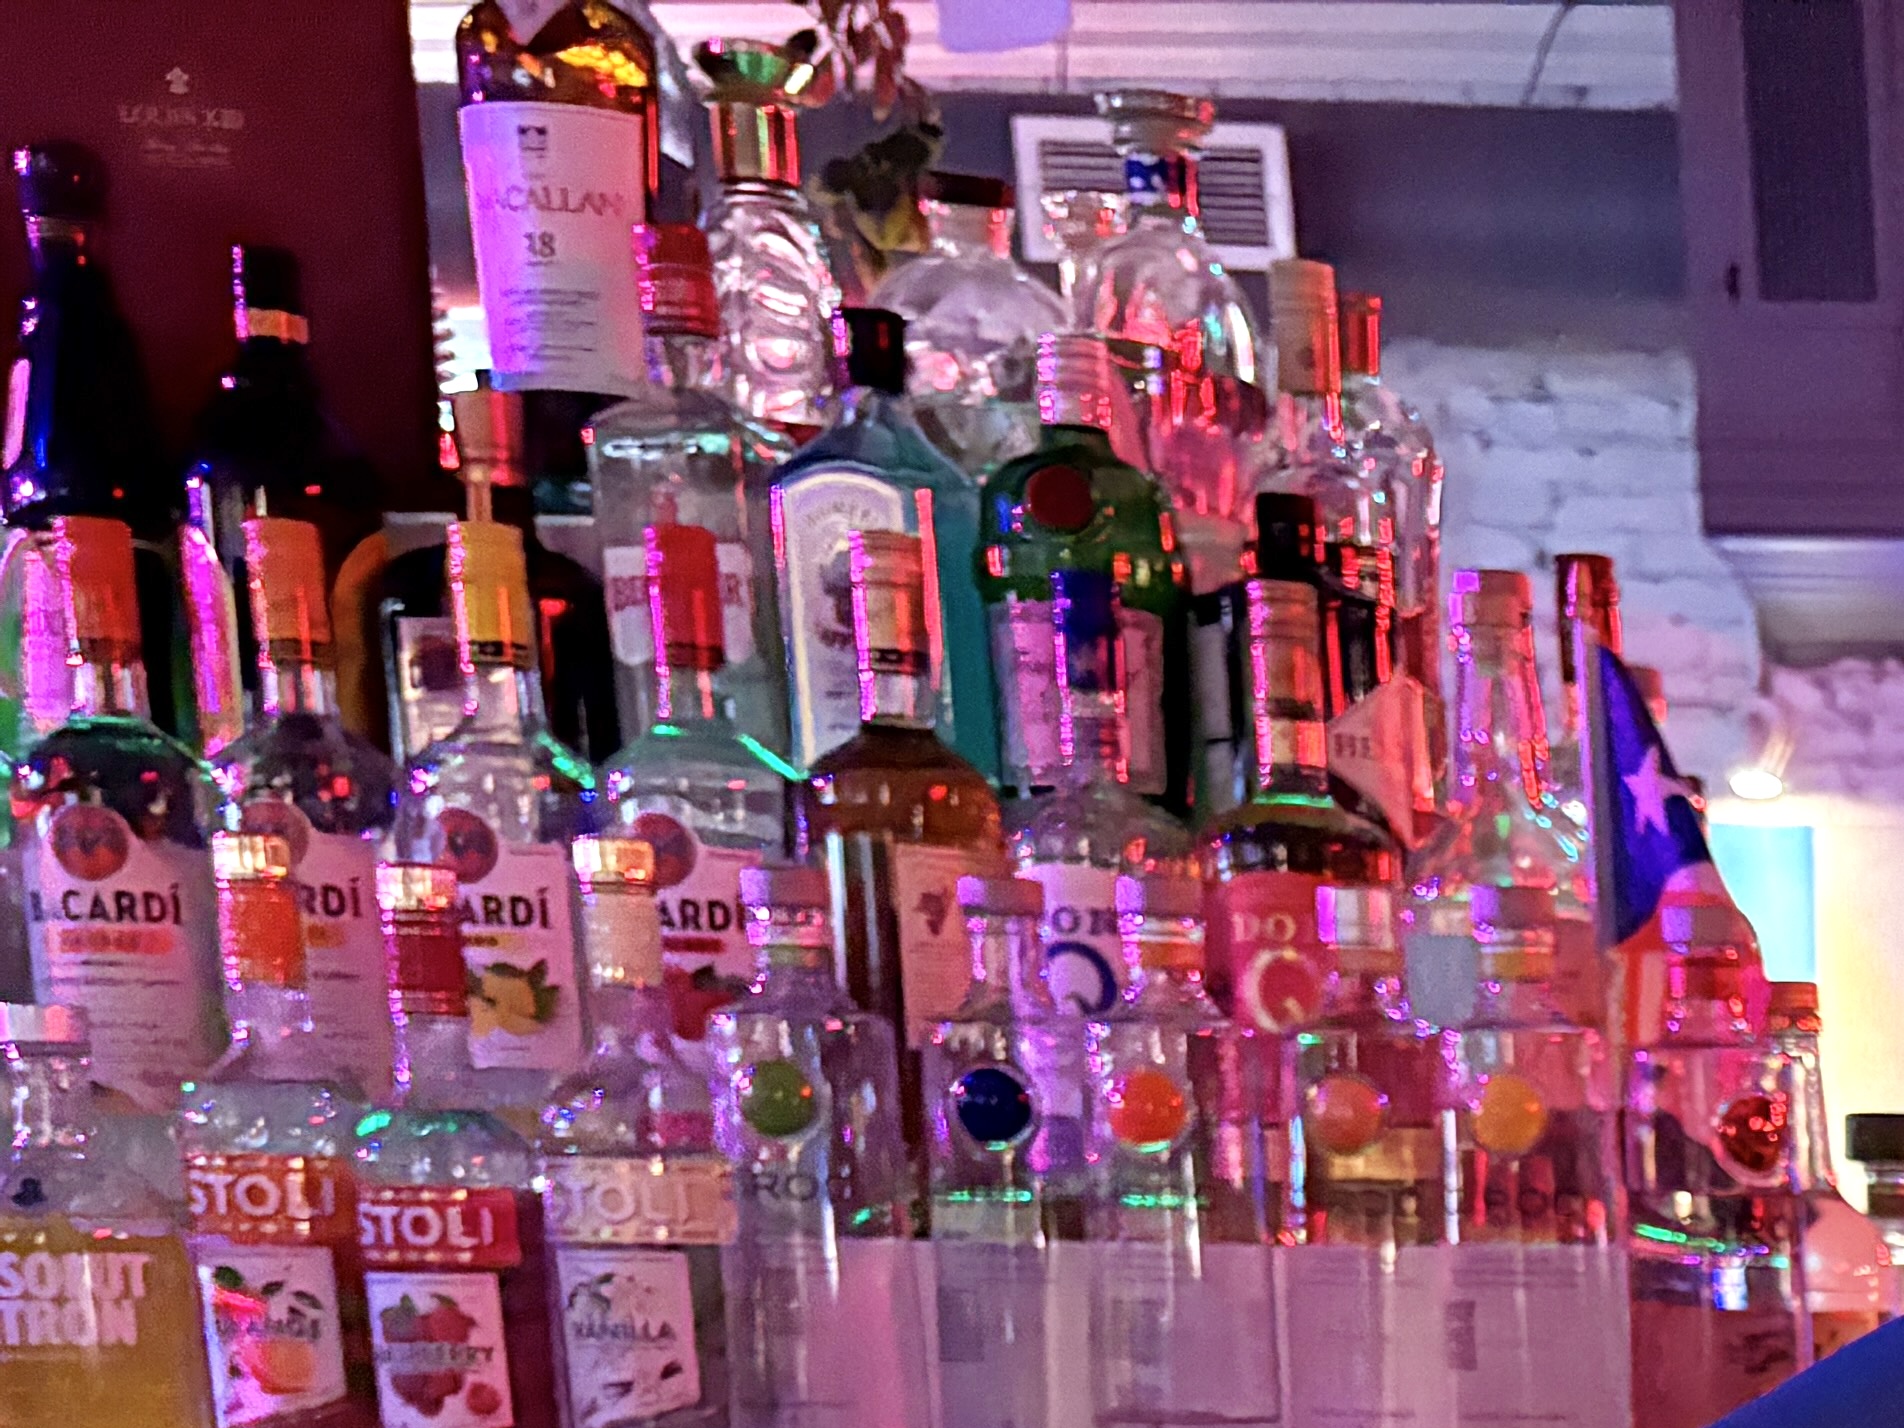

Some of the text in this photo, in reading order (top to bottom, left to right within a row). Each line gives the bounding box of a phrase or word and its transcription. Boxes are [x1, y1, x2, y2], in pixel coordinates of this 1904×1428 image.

[523, 231, 556, 258] 18
[189, 1169, 336, 1221] STOLI
[359, 1201, 494, 1249] STOLI
